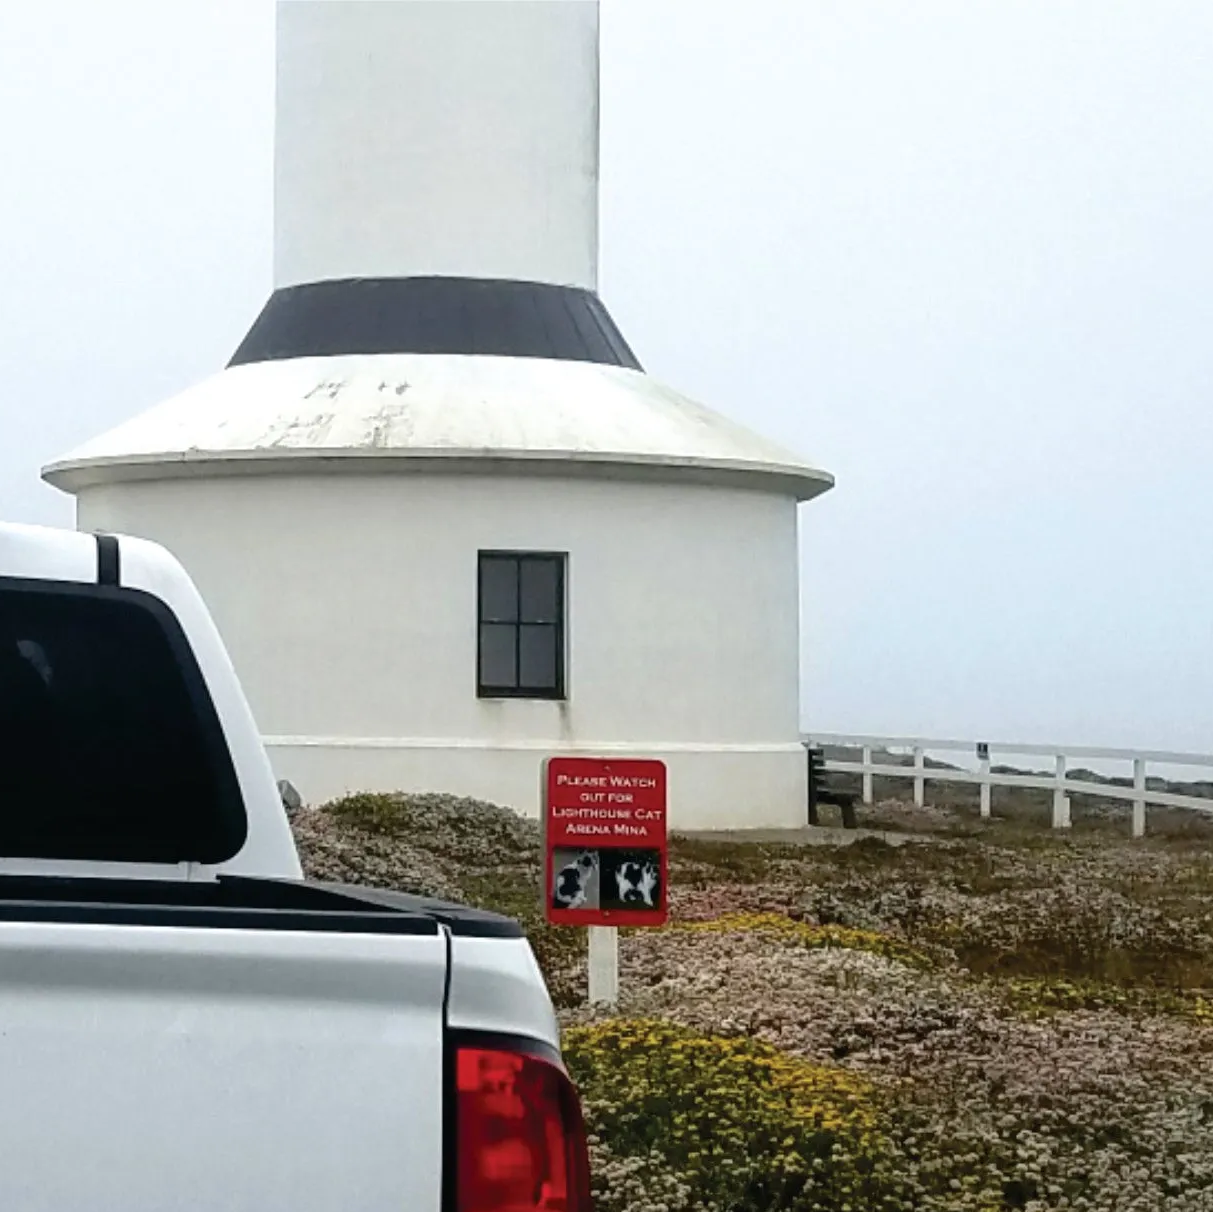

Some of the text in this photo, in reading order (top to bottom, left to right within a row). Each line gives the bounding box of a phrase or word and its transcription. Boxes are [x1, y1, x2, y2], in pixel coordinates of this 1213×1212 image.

[557, 775, 656, 788] PLEASE WATCH
[579, 793, 634, 803] OUT FOR
[552, 806, 662, 820] LIGHTHOUSE CAT
[565, 823, 648, 836] ARENA MINA
